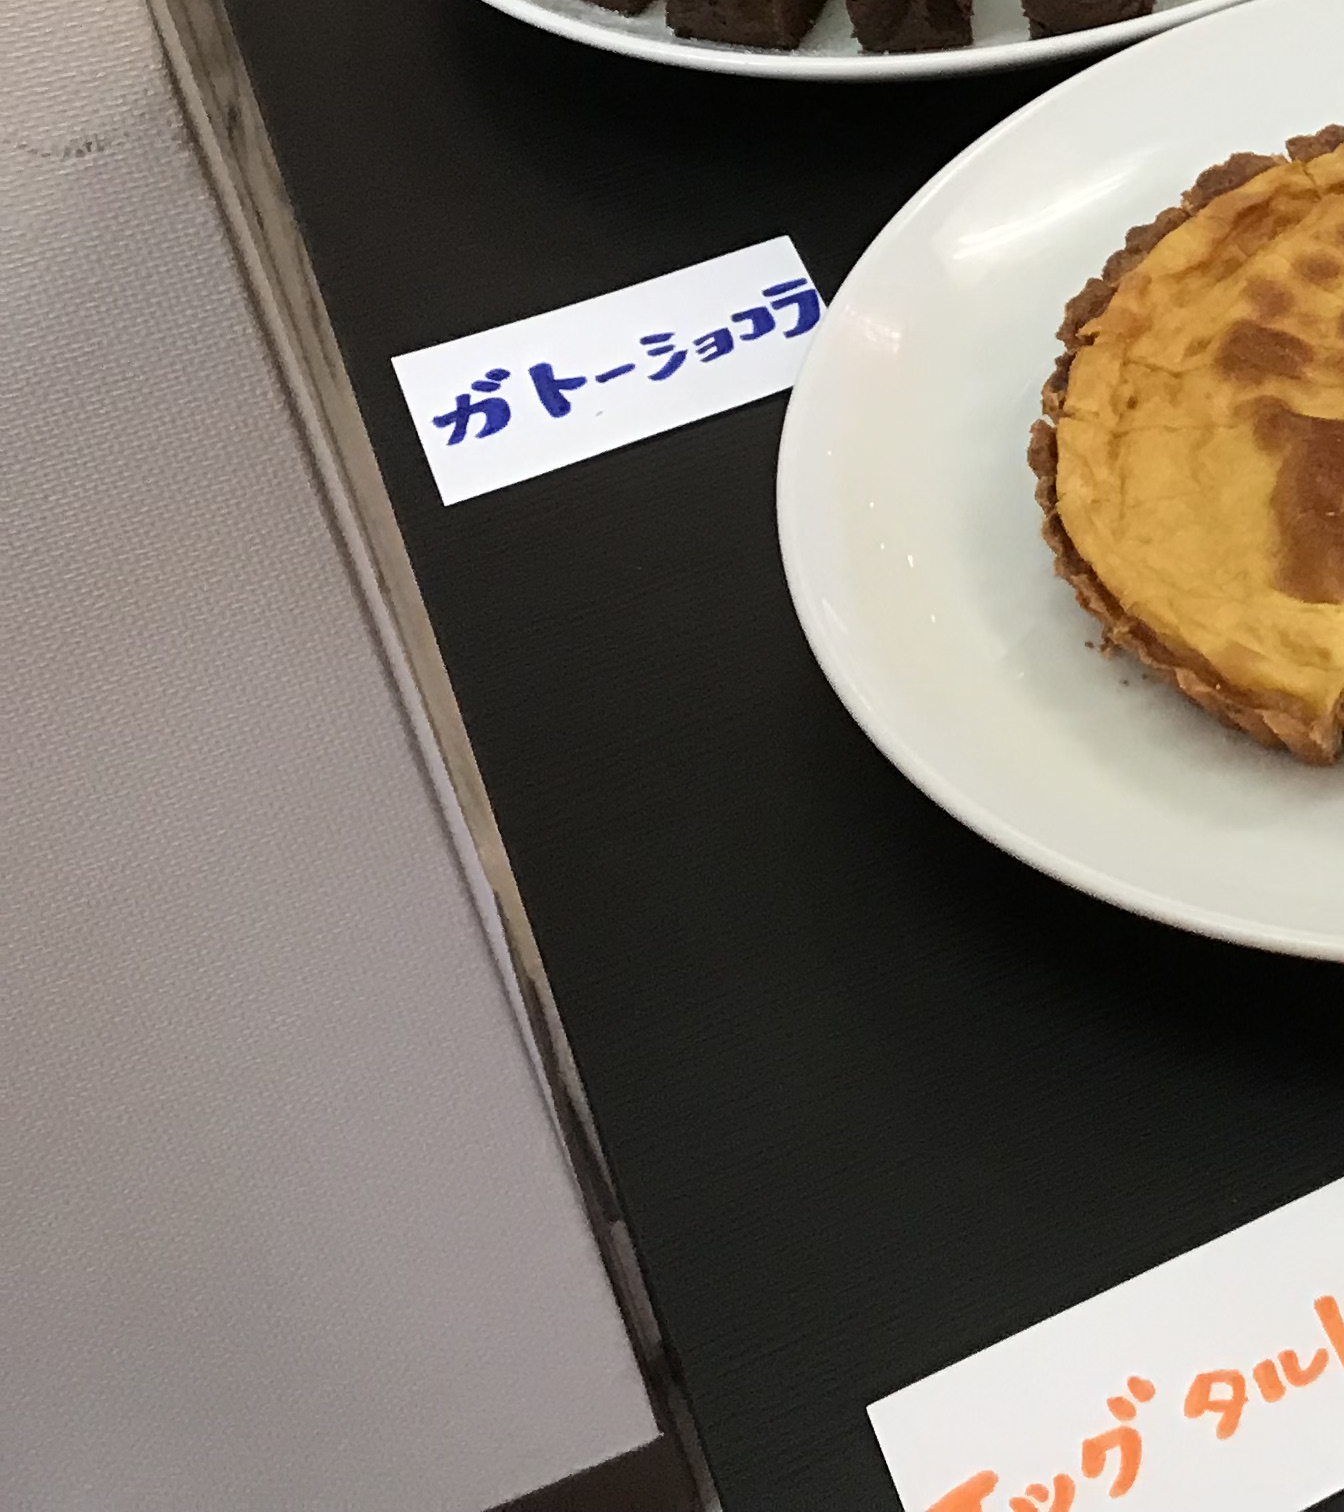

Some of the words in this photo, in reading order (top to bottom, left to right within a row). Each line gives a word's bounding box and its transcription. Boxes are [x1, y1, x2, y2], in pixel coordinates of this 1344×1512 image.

[431, 277, 822, 447] ガトーショコラ
